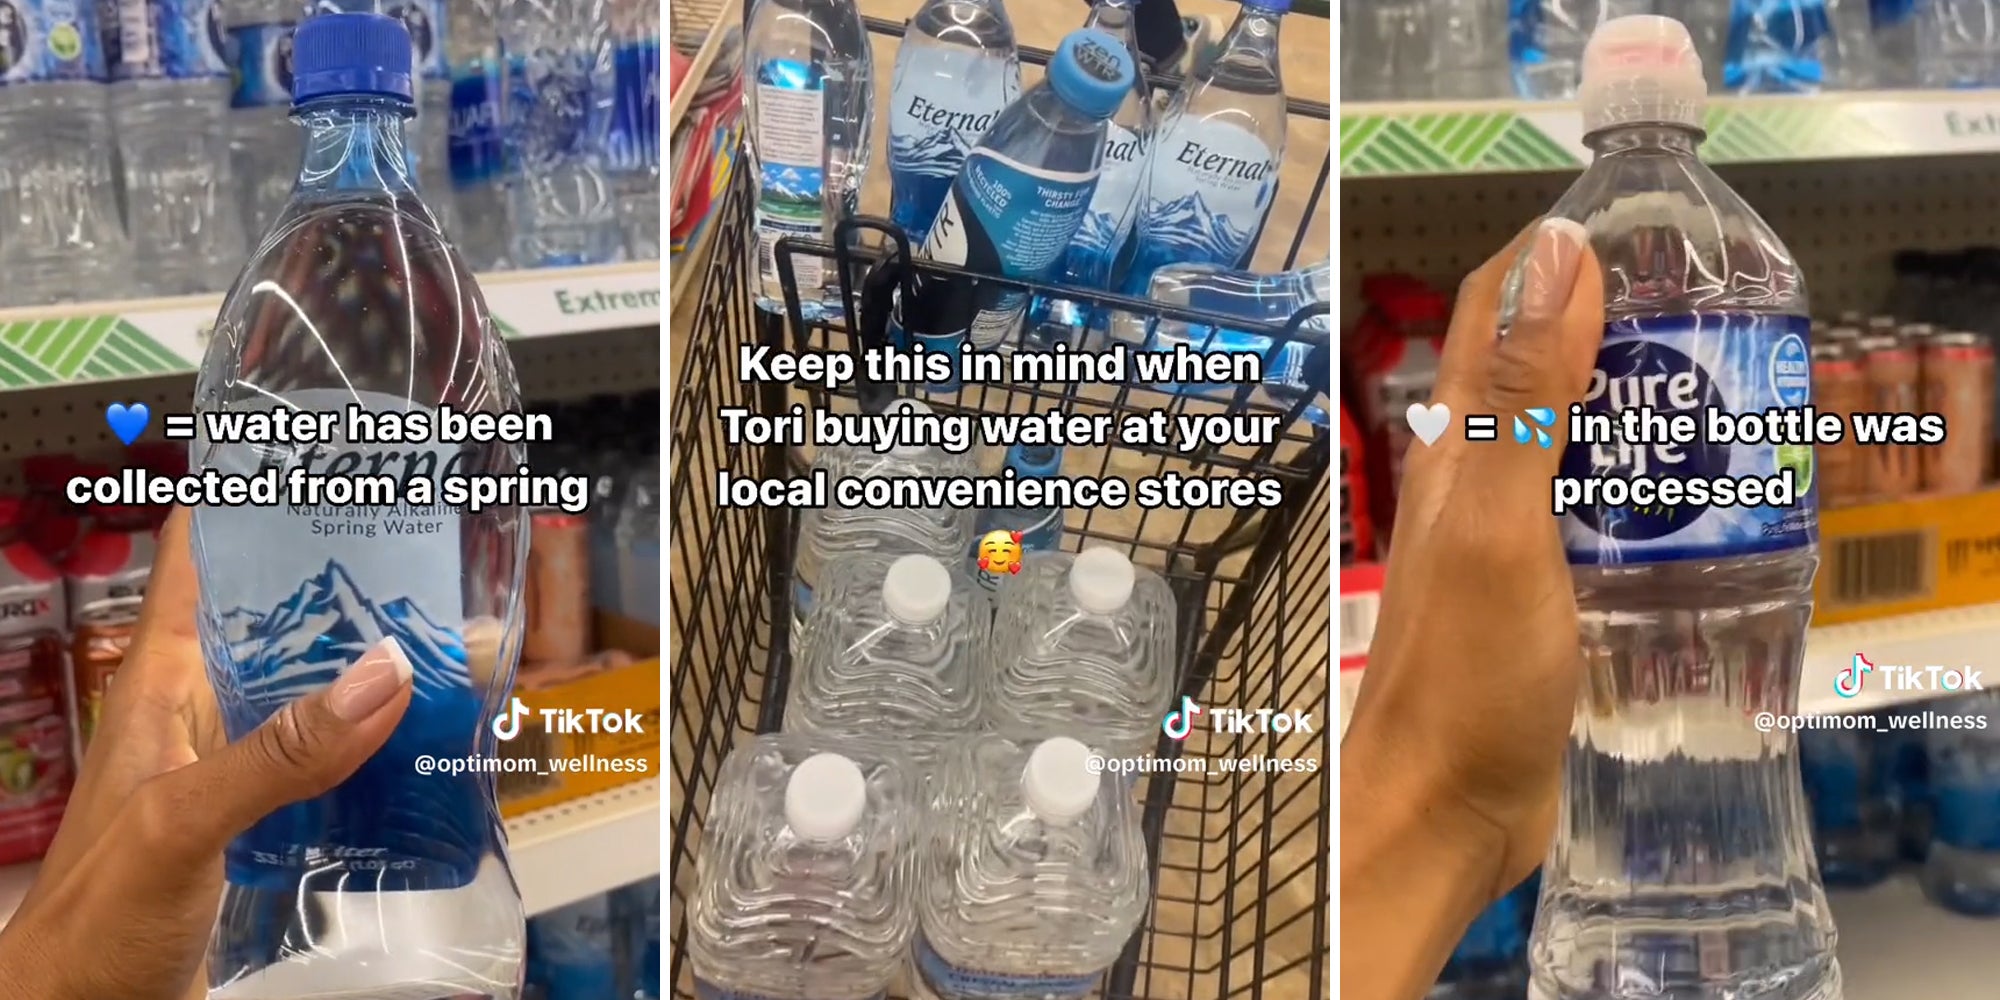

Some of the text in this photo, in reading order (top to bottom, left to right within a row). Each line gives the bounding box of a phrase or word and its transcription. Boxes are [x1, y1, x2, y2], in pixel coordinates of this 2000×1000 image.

[1176, 140, 1270, 181] Eternal
[311, 518, 444, 537] Spring Water
